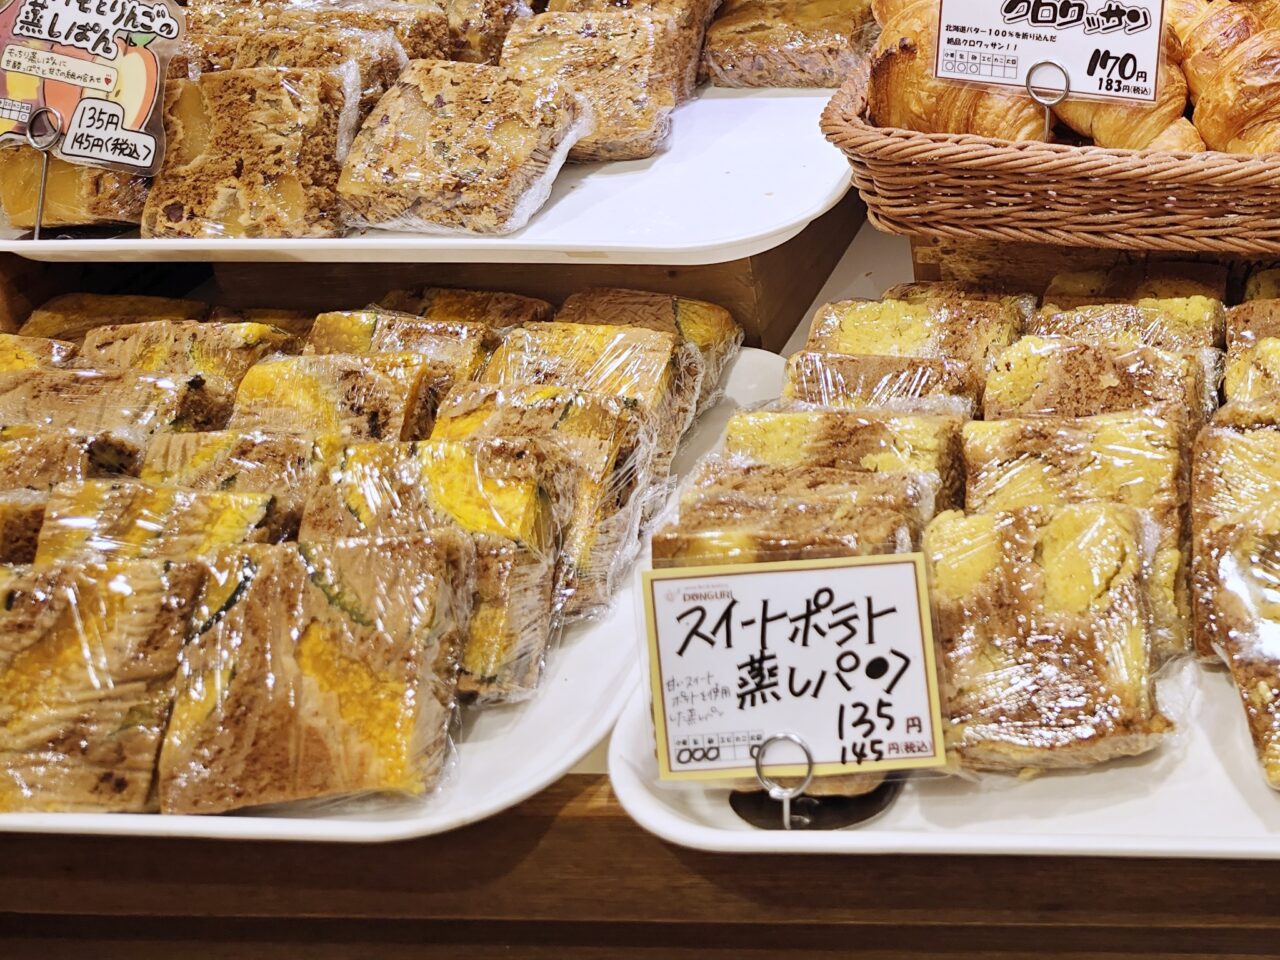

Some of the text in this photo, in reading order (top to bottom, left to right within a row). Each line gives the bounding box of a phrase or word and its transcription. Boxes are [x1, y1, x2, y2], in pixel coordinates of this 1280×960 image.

[20, 0, 112, 54] 蒸しぱん
[1086, 48, 1147, 82] 170円
[78, 106, 119, 131] 135円
[676, 587, 897, 656] スイートポテト
[737, 649, 911, 710] 蒸しパン
